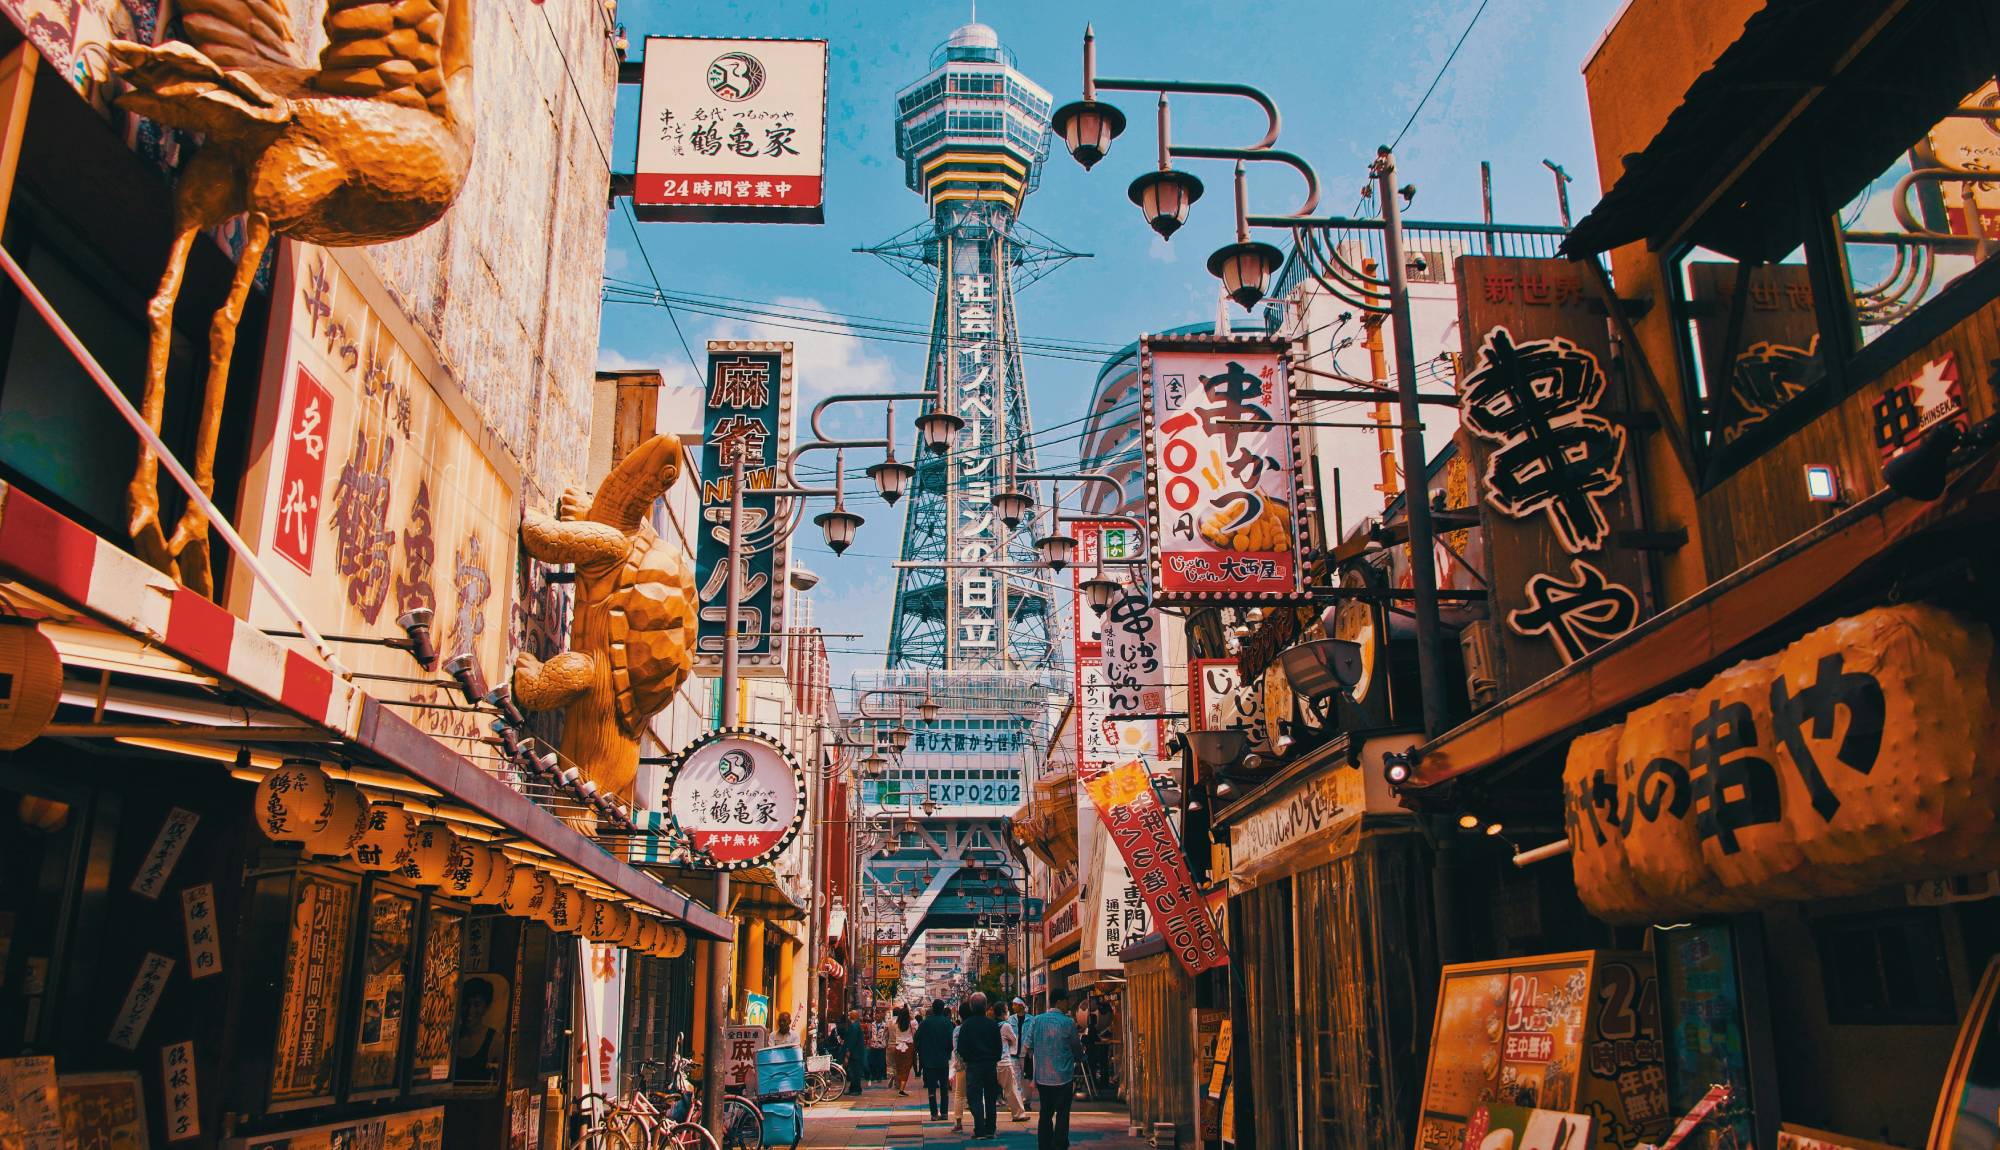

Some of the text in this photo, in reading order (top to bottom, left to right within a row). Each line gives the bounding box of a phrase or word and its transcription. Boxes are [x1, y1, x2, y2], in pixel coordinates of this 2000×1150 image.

[690, 121, 800, 158] 鶴亀家
[663, 179, 793, 198] 24時間営業中
[1485, 273, 1583, 306] 新世界
[1165, 376, 1185, 407] 全て
[706, 356, 769, 468] 麻雀
[1919, 399, 1962, 428] SHINSEKA
[959, 275, 997, 648] 社会イノベーションの日立
[1194, 361, 1281, 532] 串かつ
[280, 397, 324, 554] 名代
[914, 733, 1021, 752] 再び大阪から世界
[267, 773, 293, 834] 鶴亀家
[709, 797, 778, 825] 鶴亀家
[708, 833, 761, 846] 年中無休
[1123, 866, 1147, 947] 専門店
[1106, 898, 1120, 957] 通天閣店
